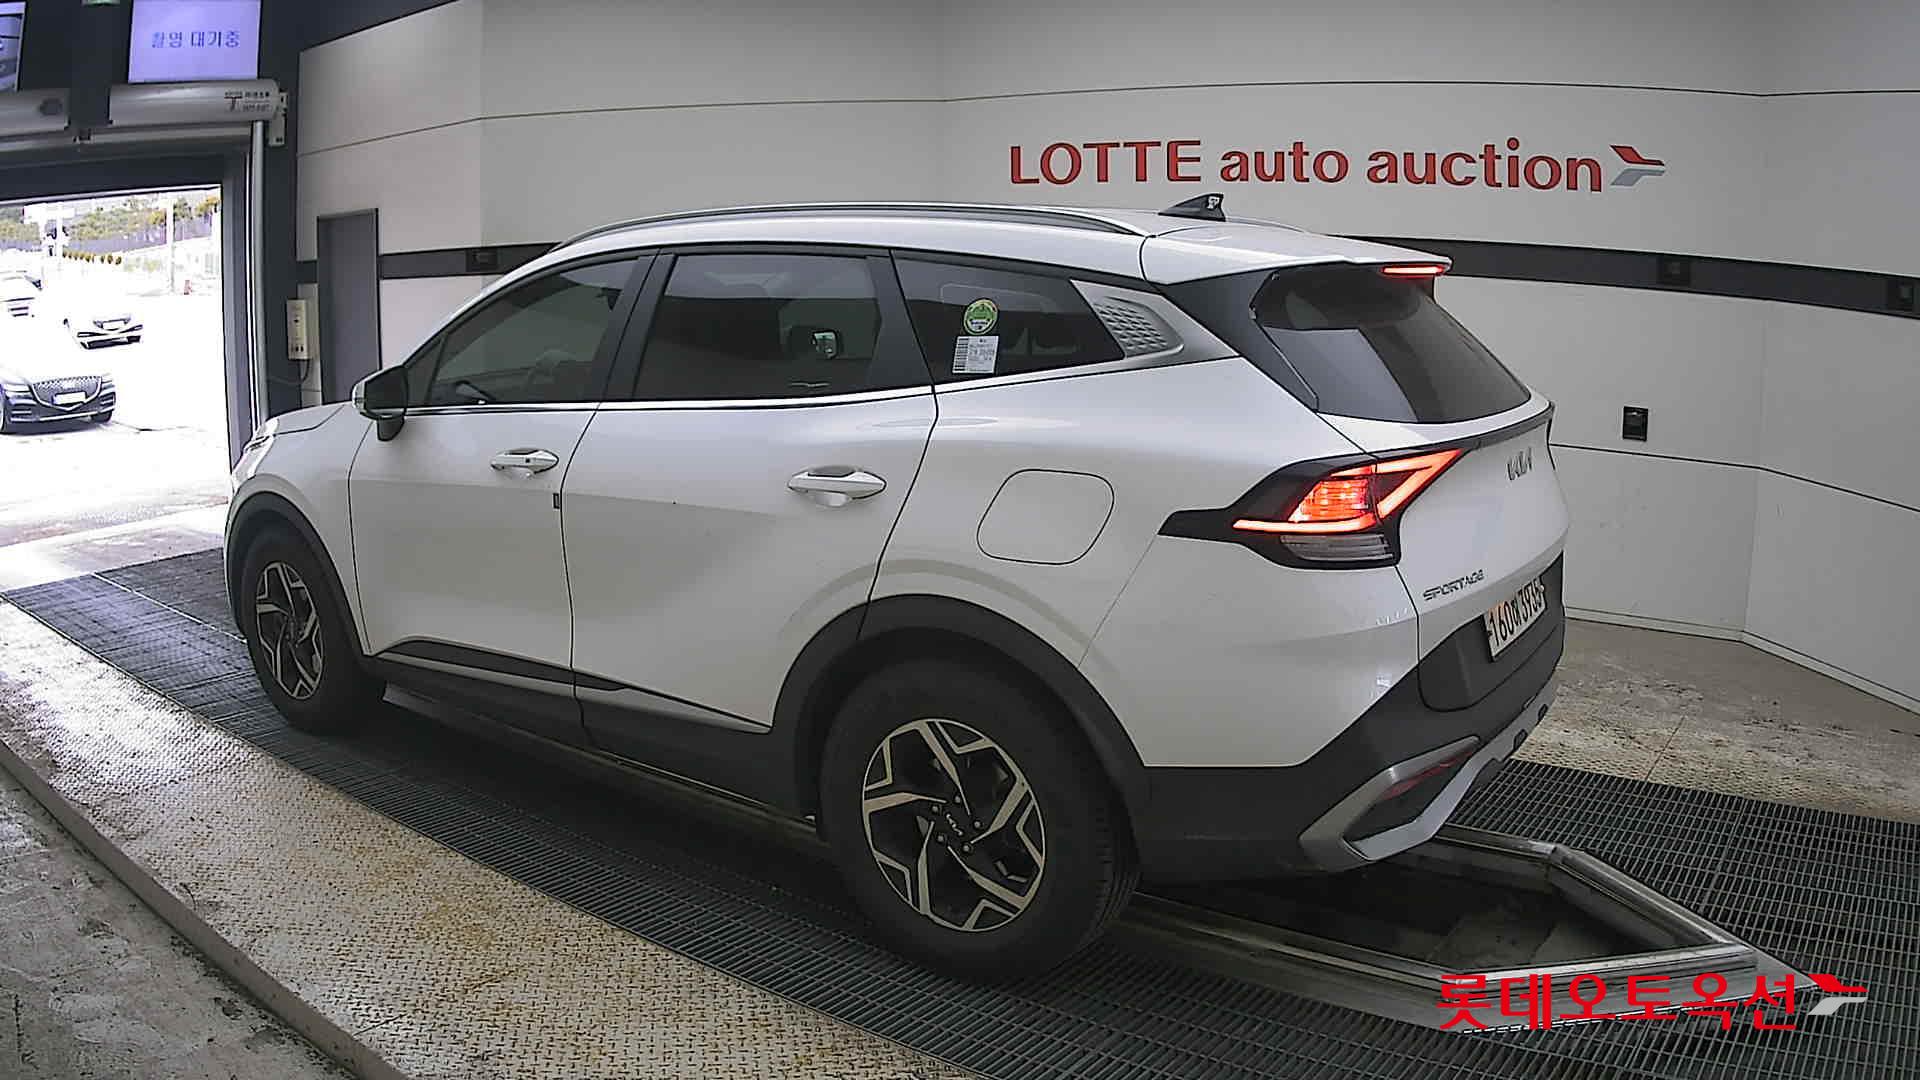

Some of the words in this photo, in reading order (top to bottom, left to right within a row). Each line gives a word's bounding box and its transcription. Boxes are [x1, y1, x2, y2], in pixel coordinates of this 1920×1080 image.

[191, 31, 240, 48] 대기중
[1009, 140, 1201, 185] LOTTE
[1220, 142, 1349, 184] auto
[1367, 137, 1602, 192] auction
[1423, 569, 1485, 602] SPORTAGE
